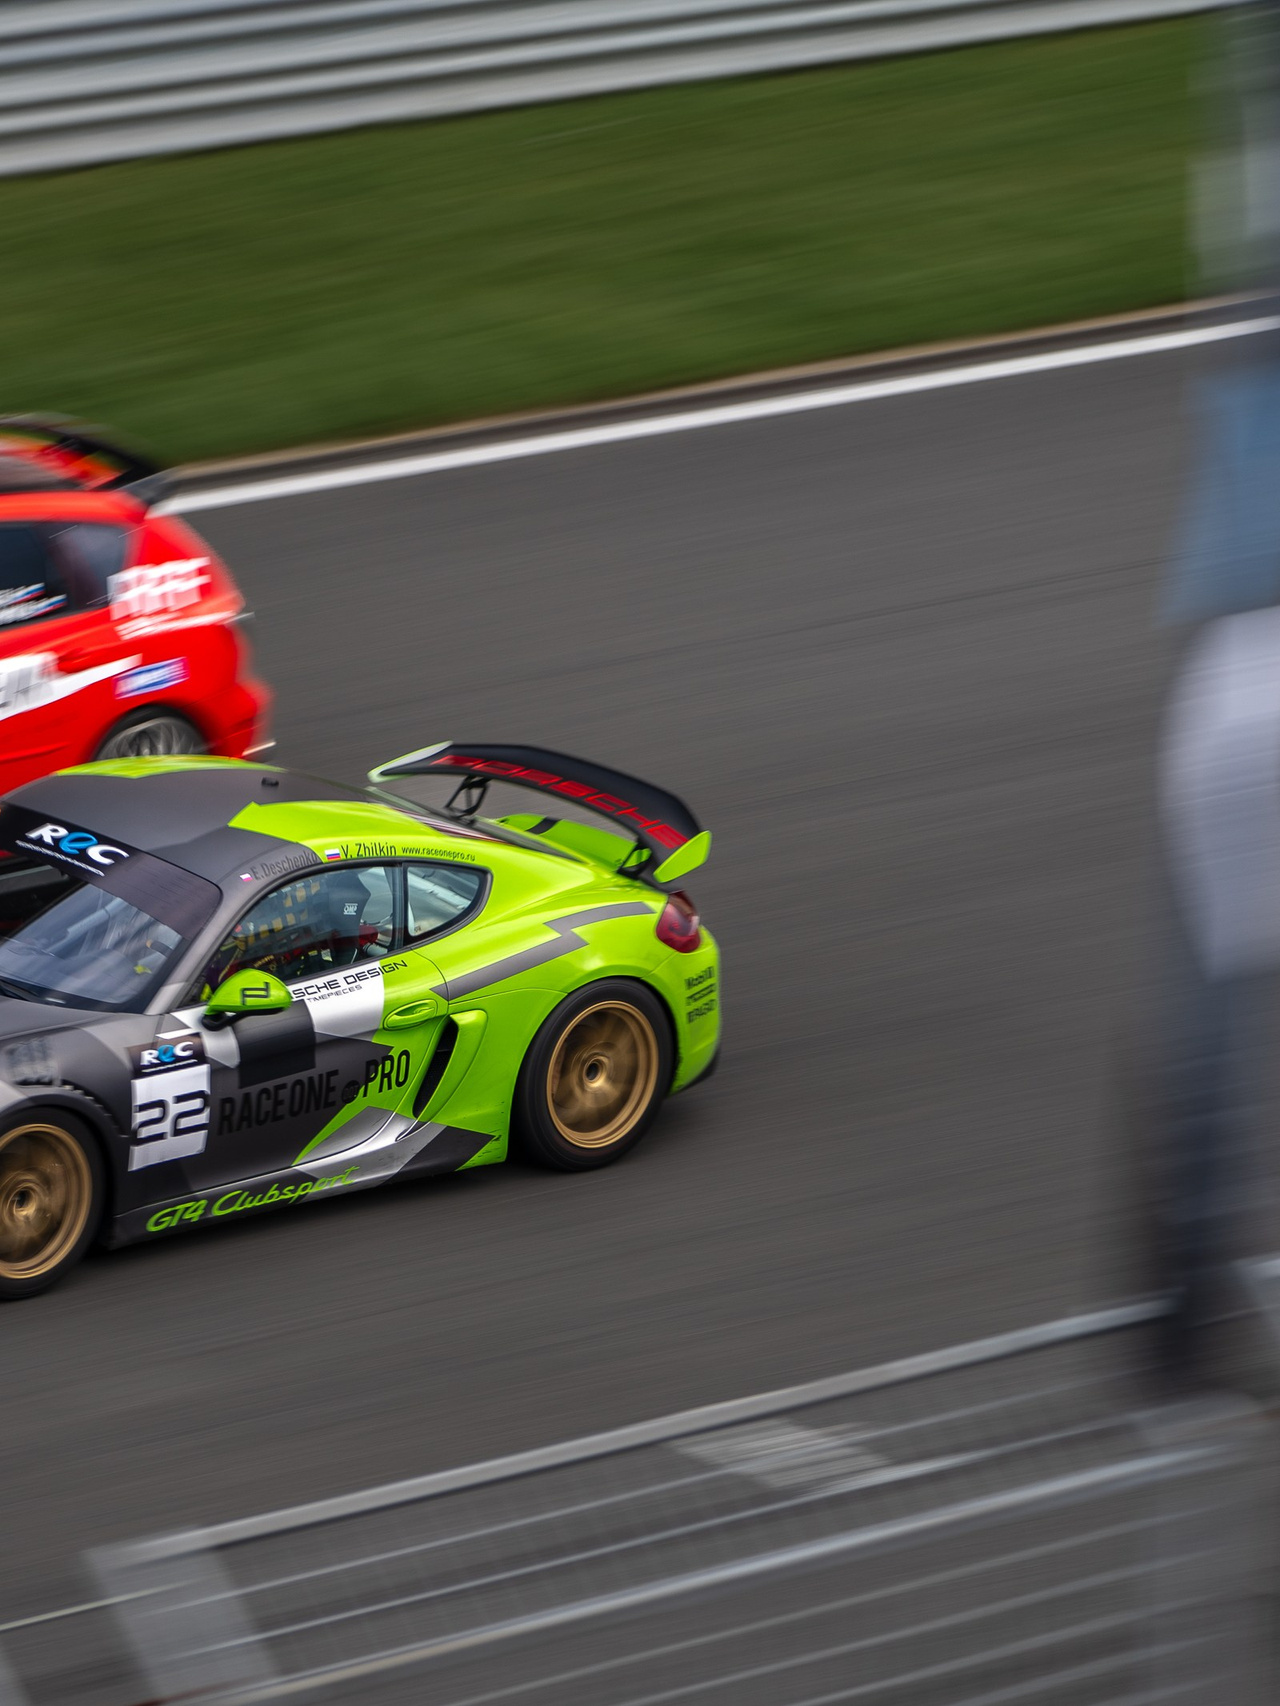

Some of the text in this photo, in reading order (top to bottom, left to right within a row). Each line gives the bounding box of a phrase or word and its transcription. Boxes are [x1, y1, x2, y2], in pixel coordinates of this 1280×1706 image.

[430, 754, 690, 849] PORSCHE
[355, 842, 397, 858] Zhilkin
[401, 845, 476, 861] www.raceonepro.ru
[292, 960, 408, 998] SCHE DESIGN
[307, 984, 362, 1003] TIMEPIECES
[362, 1049, 411, 1099] PRO
[131, 1089, 210, 1147] 22
[146, 1165, 360, 1232] GT4 Clubsport
